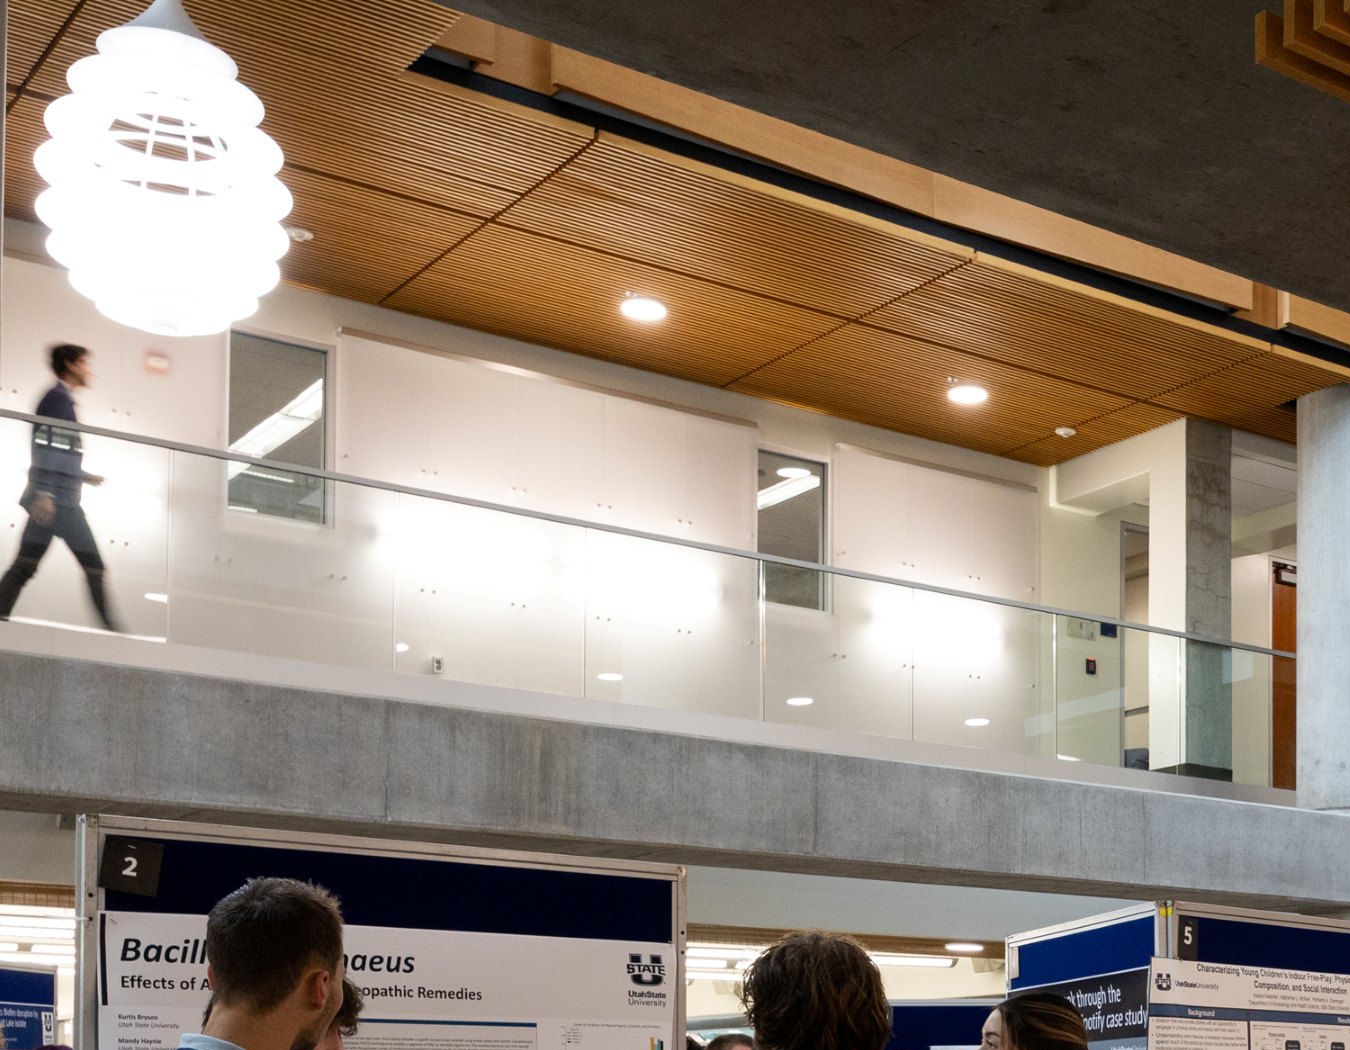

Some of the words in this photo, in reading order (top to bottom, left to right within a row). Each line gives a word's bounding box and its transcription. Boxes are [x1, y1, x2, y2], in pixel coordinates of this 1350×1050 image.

[121, 856, 138, 877] 2
[1183, 926, 1193, 945] 5
[120, 937, 207, 965] Bacill
[1196, 963, 1240, 977] Characterizing
[1240, 967, 1260, 978] Young
[1260, 969, 1288, 979] Children's
[1289, 971, 1307, 980] Indoor
[121, 975, 175, 990] Effects
[180, 976, 196, 990] of
[356, 985, 414, 1000] eopathic
[418, 986, 482, 1001] Remedies
[628, 990, 667, 999] UtahState
[1254, 980, 1291, 991] Composition,
[1292, 984, 1302, 992] and
[1303, 983, 1319, 992] Social
[1320, 985, 1347, 995] Interaction
[628, 998, 667, 1008] University
[1076, 985, 1107, 1009] through
[1107, 983, 1122, 1004] the
[137, 1014, 158, 1022] Bryson
[1106, 1013, 1124, 1029] case
[1124, 1005, 1148, 1029] study
[1187, 1008, 1216, 1017] Background
[152, 1022, 180, 1030] University
[118, 1037, 139, 1046] Mandy
[140, 1038, 162, 1046] Haynie
